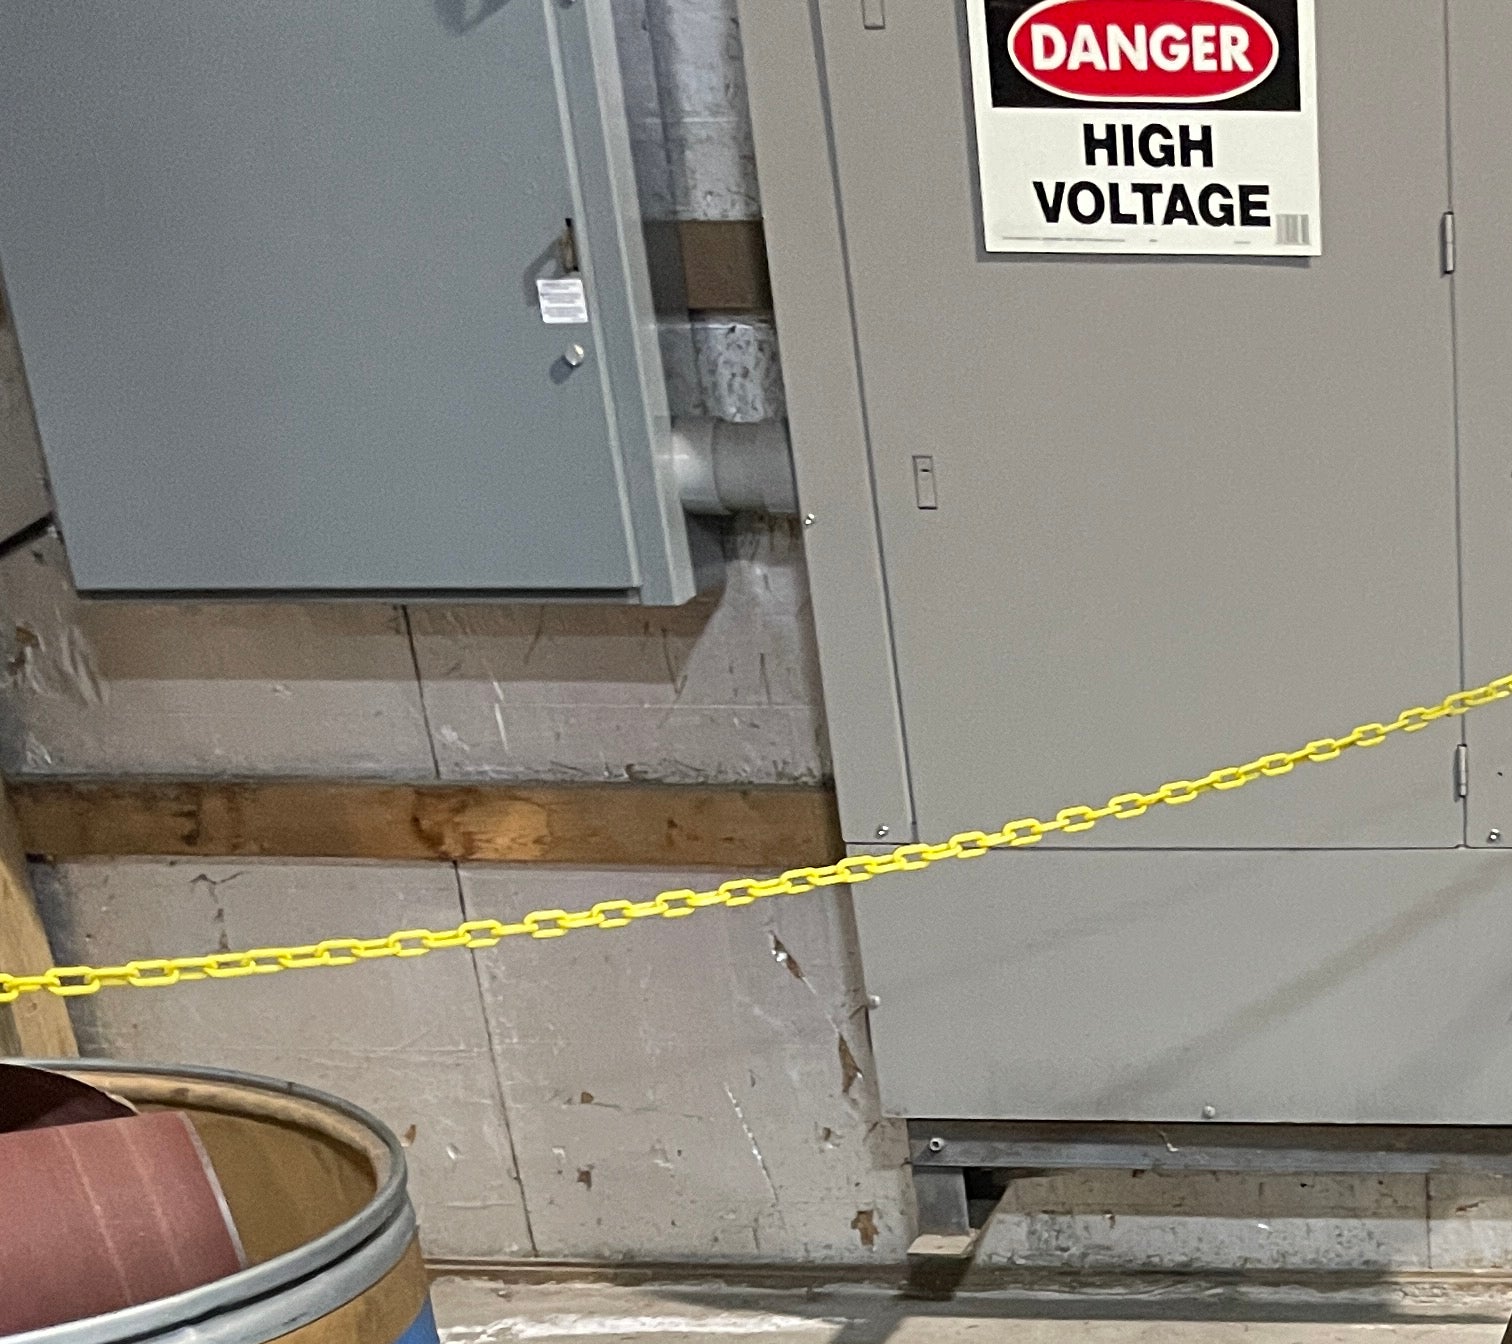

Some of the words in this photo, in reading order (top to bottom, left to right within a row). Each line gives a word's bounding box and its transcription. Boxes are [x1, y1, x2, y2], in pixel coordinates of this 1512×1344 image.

[1030, 23, 1254, 72] DANGER
[1083, 123, 1214, 168] HIGH
[1033, 181, 1271, 227] VOLTAGE
